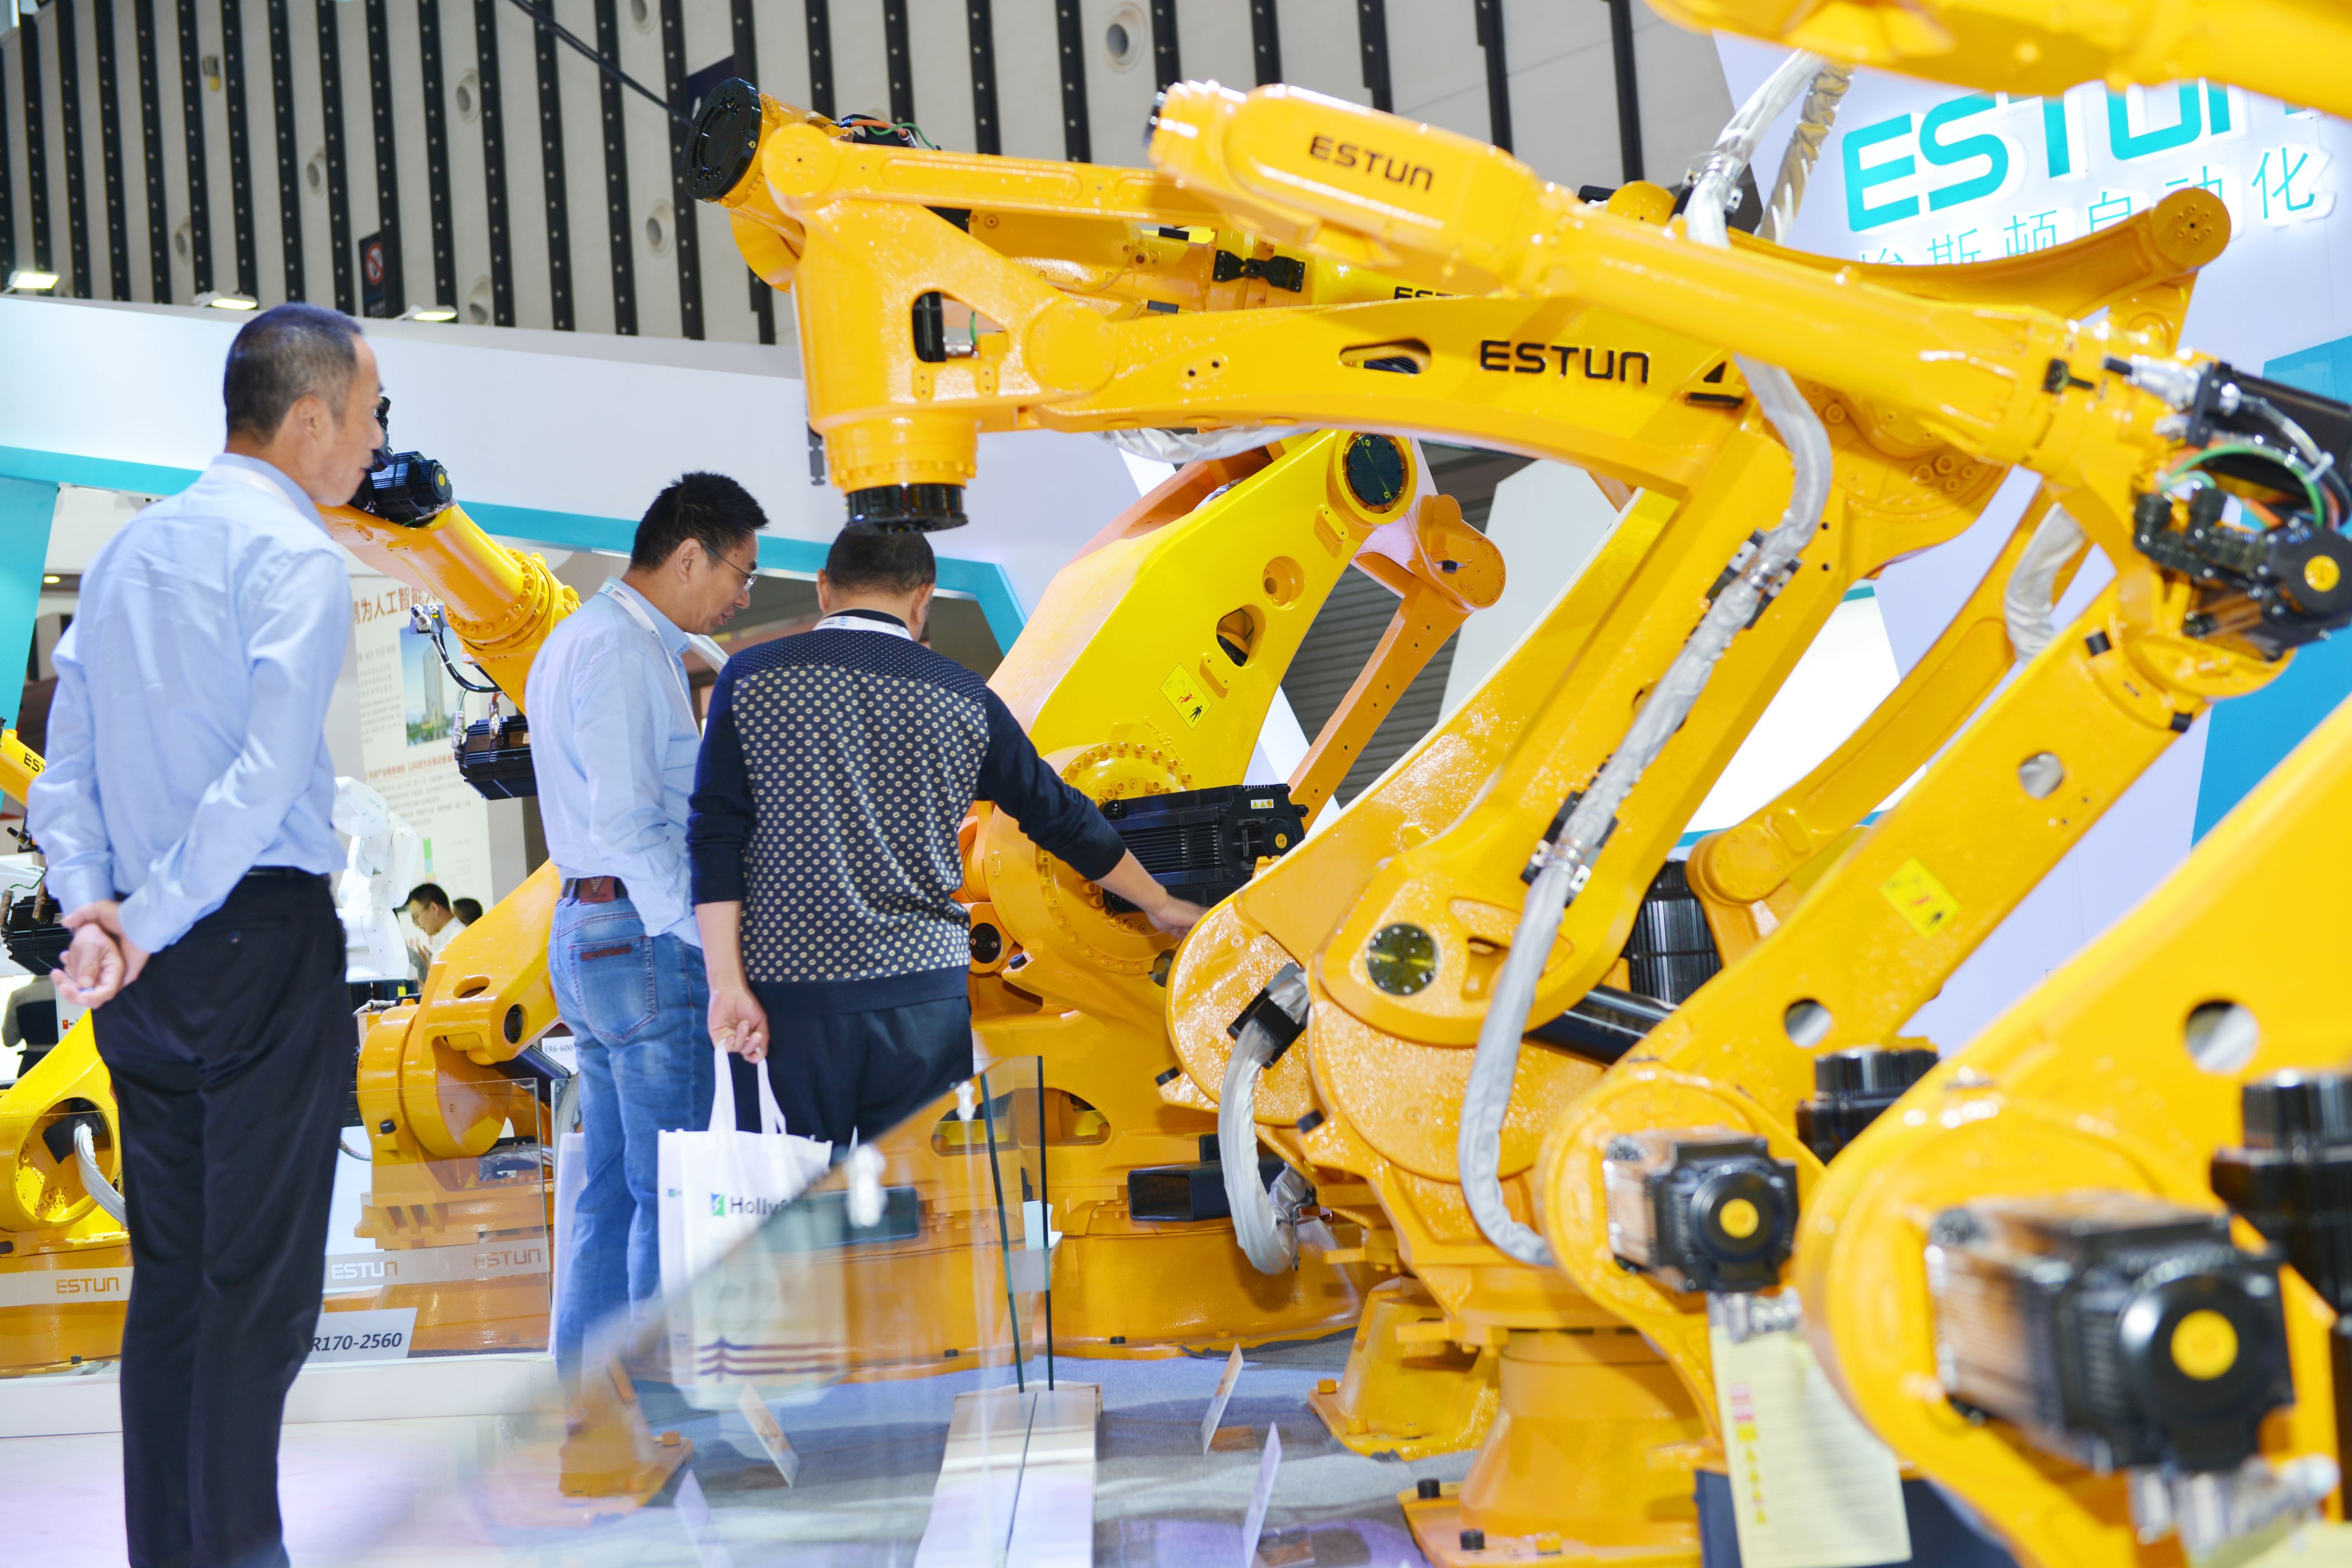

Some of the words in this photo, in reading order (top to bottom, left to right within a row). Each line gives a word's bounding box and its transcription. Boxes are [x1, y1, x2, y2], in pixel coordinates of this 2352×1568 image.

[1310, 136, 1433, 191] ESTUN
[1480, 340, 1649, 384] ESTUN
[545, 1044, 573, 1052] ER6-600
[474, 1248, 541, 1268] ESTUN
[331, 1261, 398, 1279] ESTUN
[56, 1277, 119, 1293] ESTUN
